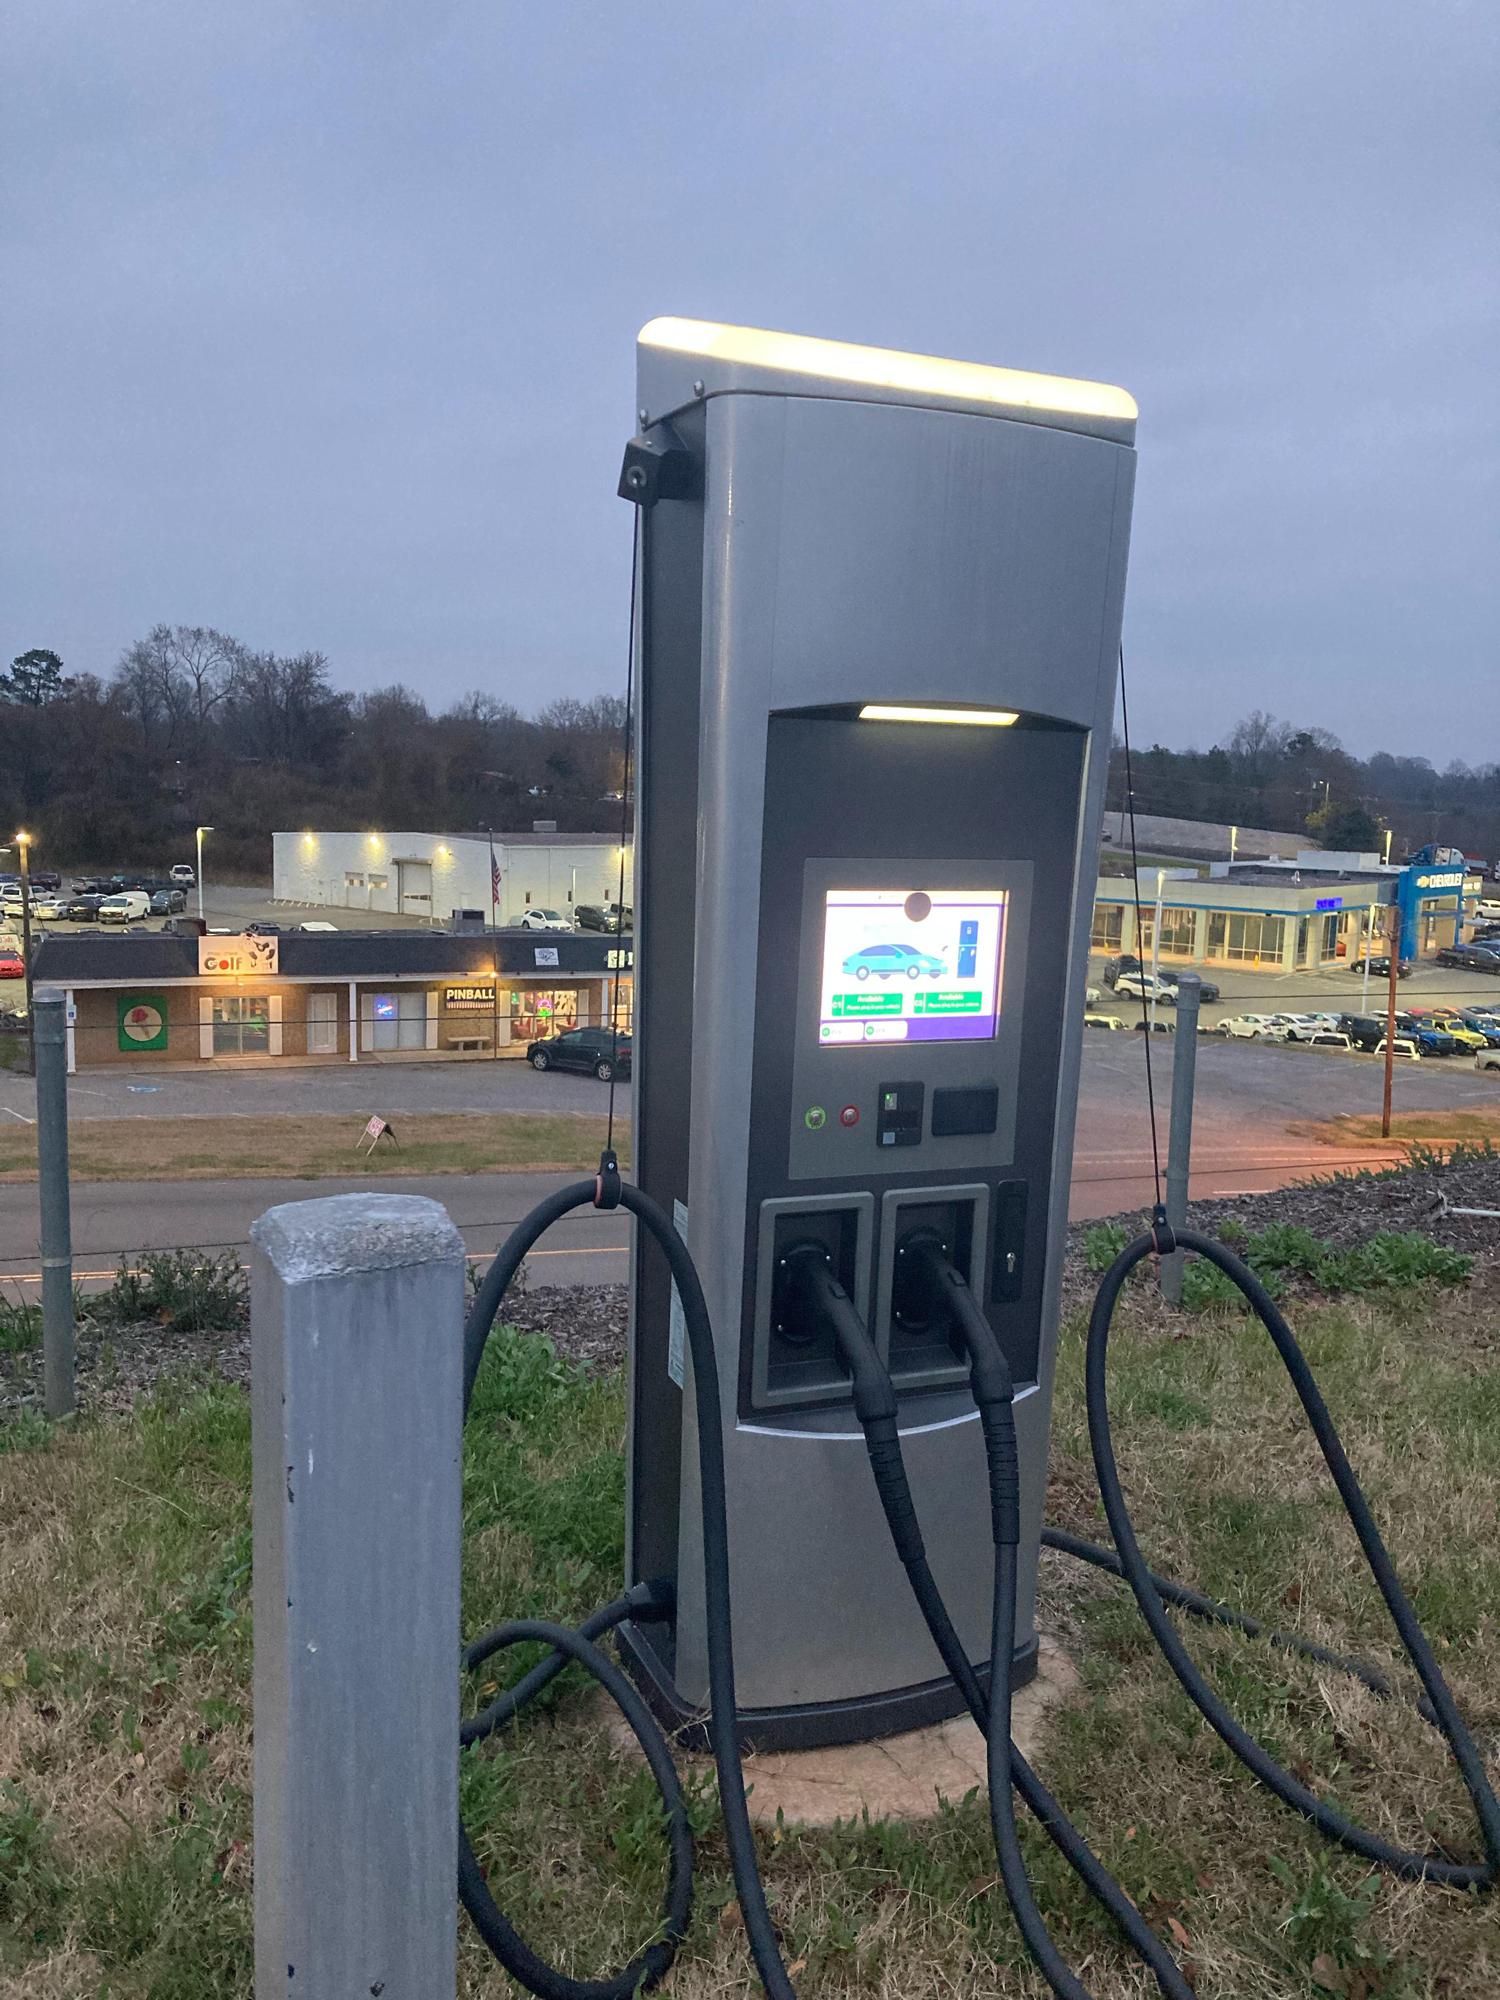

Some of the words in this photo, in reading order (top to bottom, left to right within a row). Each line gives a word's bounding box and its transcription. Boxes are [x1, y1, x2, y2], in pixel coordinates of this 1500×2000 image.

[1429, 873, 1463, 888] CHEVROLET
[204, 957, 242, 970] Golf
[446, 989, 495, 1000] PINBALL
